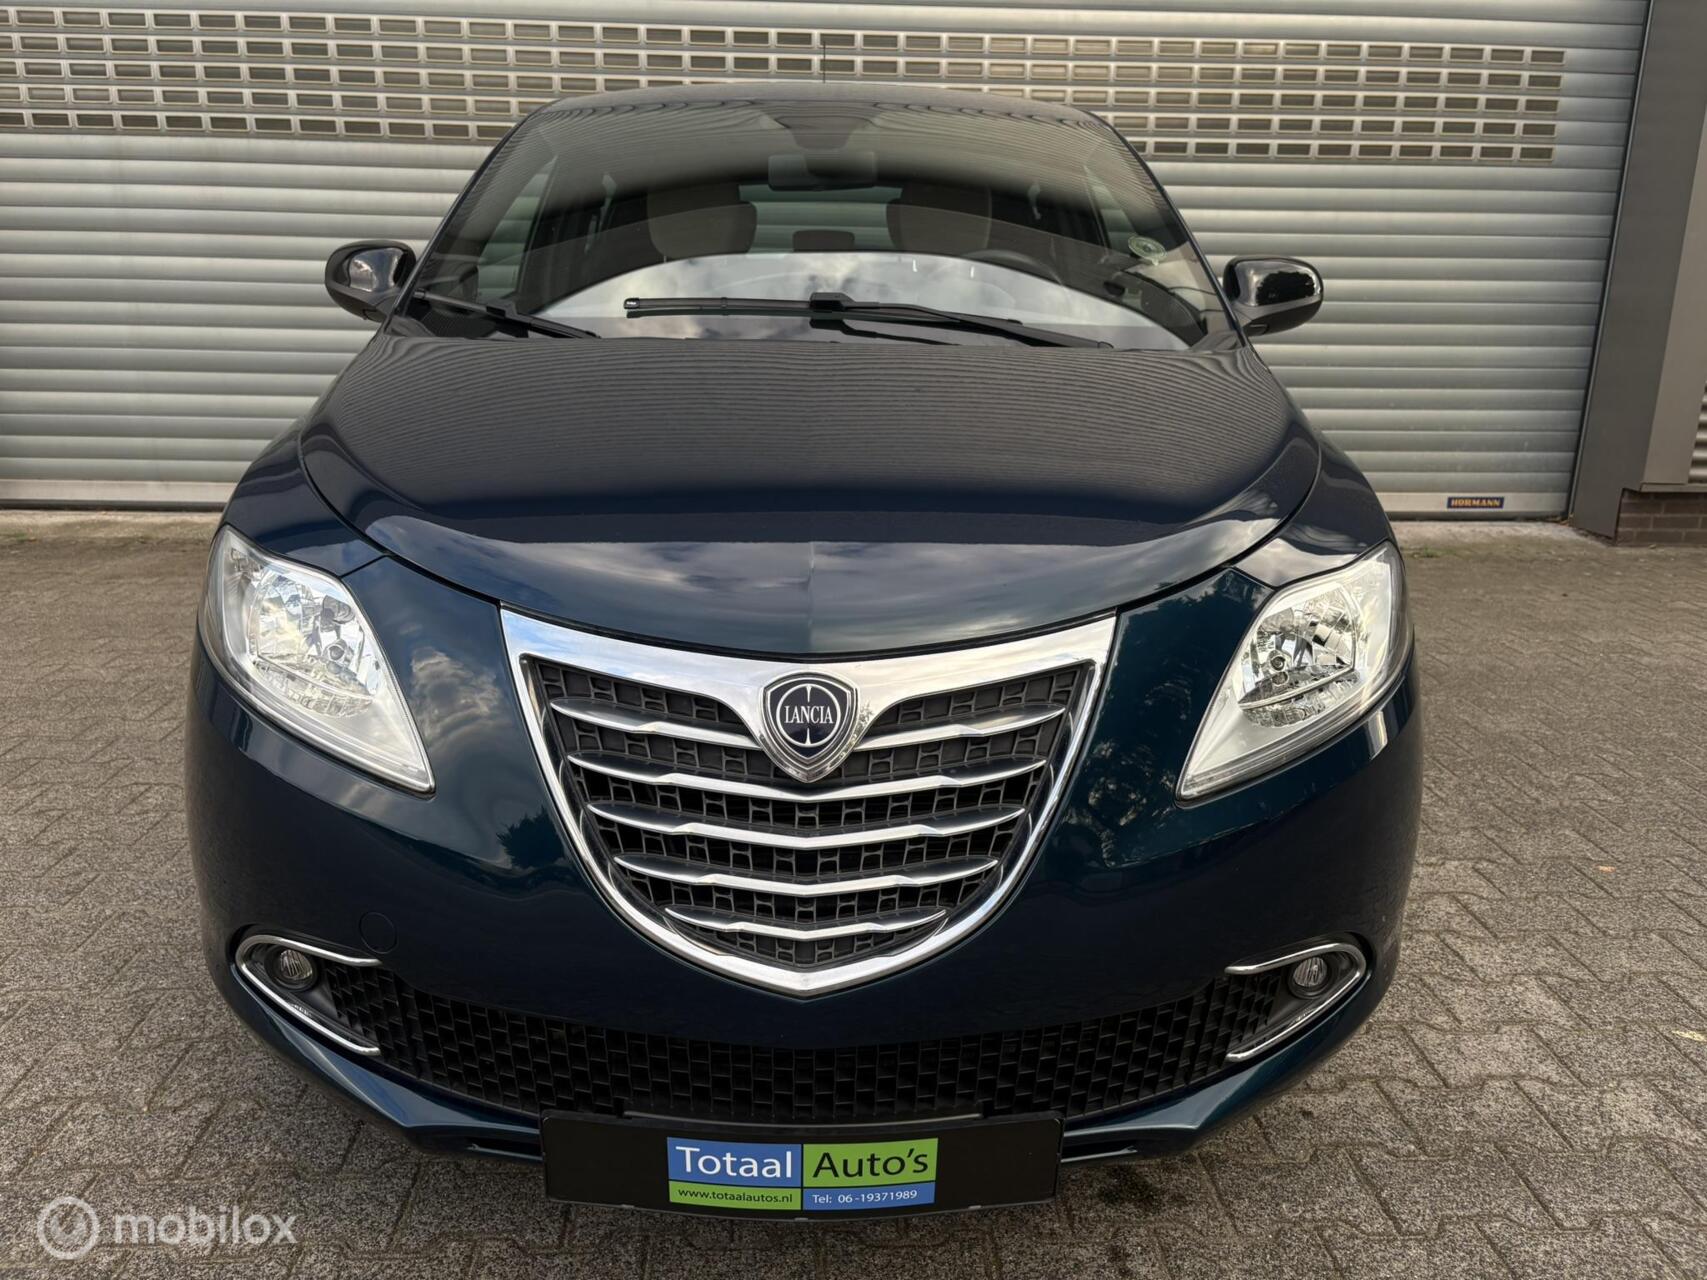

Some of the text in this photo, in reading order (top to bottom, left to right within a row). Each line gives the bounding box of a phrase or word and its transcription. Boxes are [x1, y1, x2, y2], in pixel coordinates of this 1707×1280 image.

[784, 705, 834, 724] LANCIA
[675, 1146, 928, 1178] Totaal Auto's
[678, 1188, 793, 1203] www.totaalautos.nl
[812, 1194, 832, 1204] Tel:
